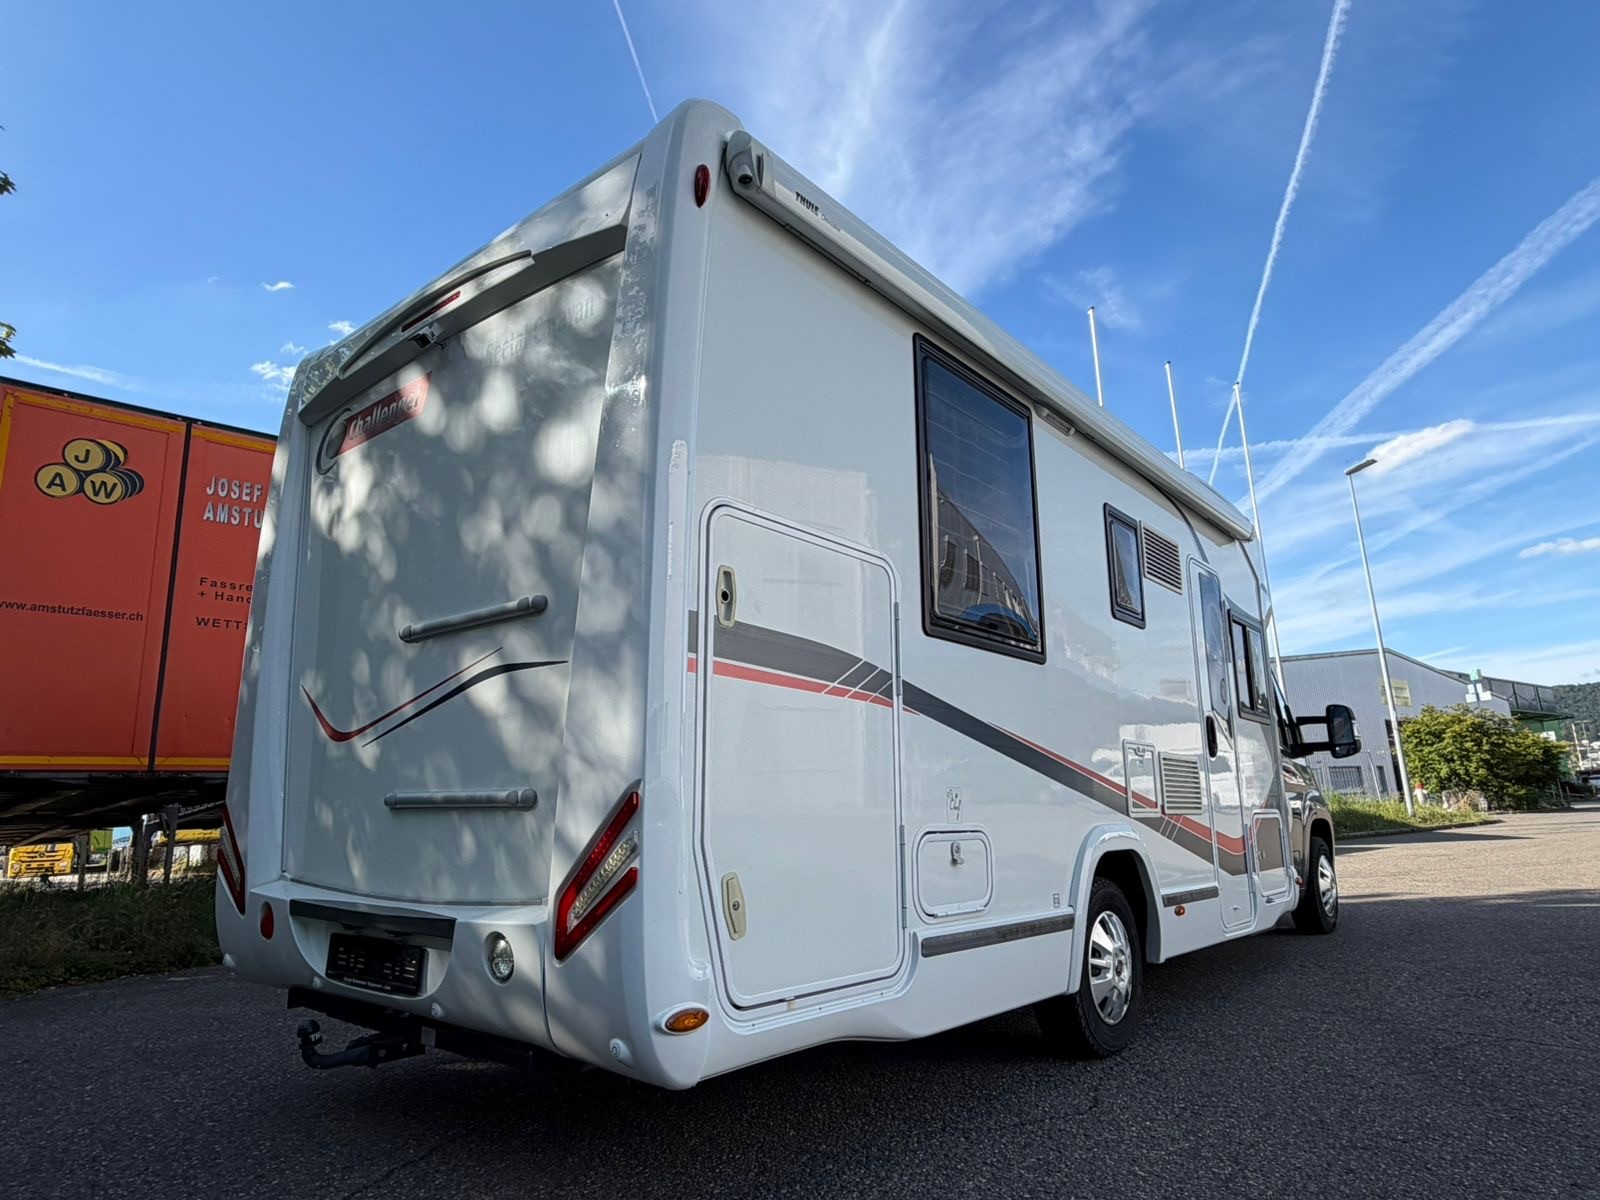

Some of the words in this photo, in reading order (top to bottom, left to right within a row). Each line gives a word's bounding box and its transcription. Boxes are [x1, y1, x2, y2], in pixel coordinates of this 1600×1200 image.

[795, 191, 820, 216] THULE
[74, 449, 91, 464] J
[46, 472, 67, 492] A
[90, 480, 118, 499] W
[206, 475, 262, 503] JOSEF
[203, 501, 263, 529] AMSTU
[199, 577, 253, 592] Fassre
